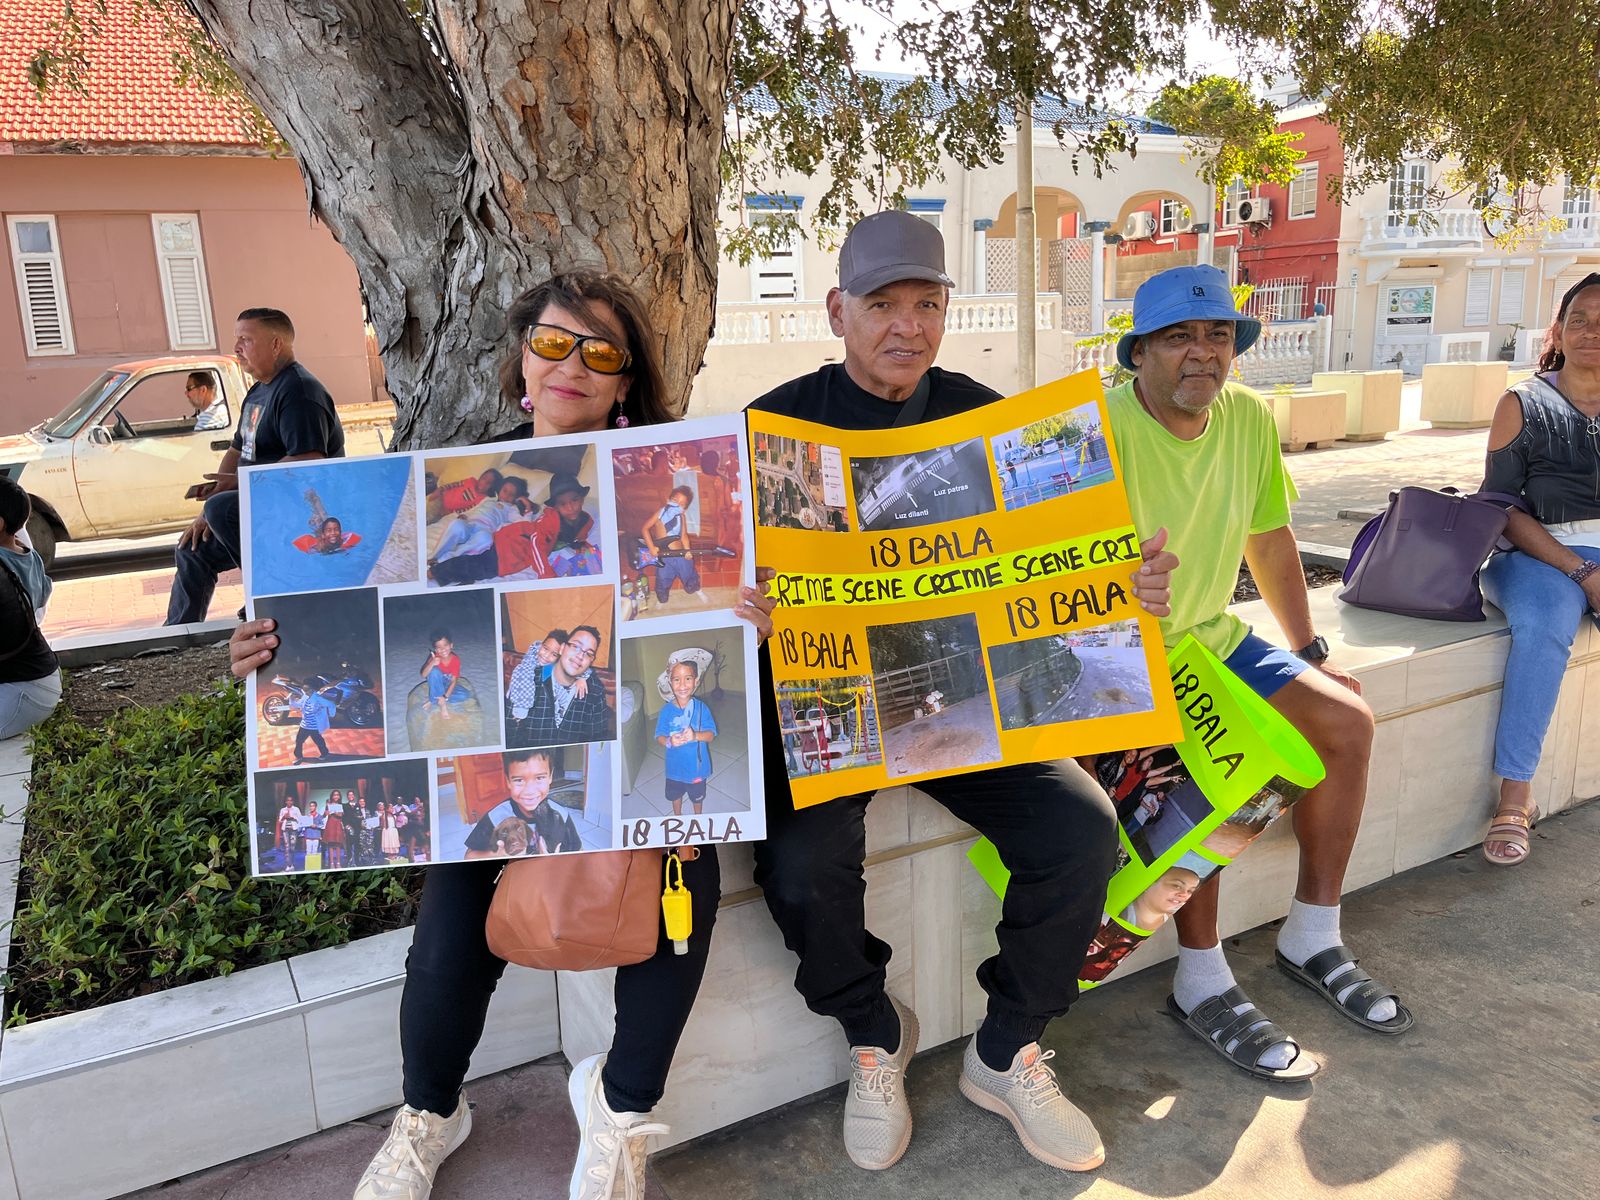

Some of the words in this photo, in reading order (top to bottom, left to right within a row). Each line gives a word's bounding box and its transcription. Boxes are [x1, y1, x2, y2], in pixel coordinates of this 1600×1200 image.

[933, 489, 947, 497] Luz
[947, 484, 969, 495] patras
[870, 537, 901, 568] 18
[908, 527, 994, 566] BALA
[776, 574, 836, 607] RIME
[842, 577, 906, 604] SCENE
[914, 561, 1004, 597] CRIME
[1013, 546, 1085, 583] SCENE
[1088, 532, 1141, 565] CRI
[1005, 596, 1040, 637] 18
[1050, 581, 1128, 626] BALA
[778, 627, 799, 666] 18
[801, 631, 859, 671] BALA
[1171, 662, 1200, 701] 18
[1184, 692, 1245, 781] BALA
[622, 818, 651, 848] 18
[659, 816, 743, 845] BALA
